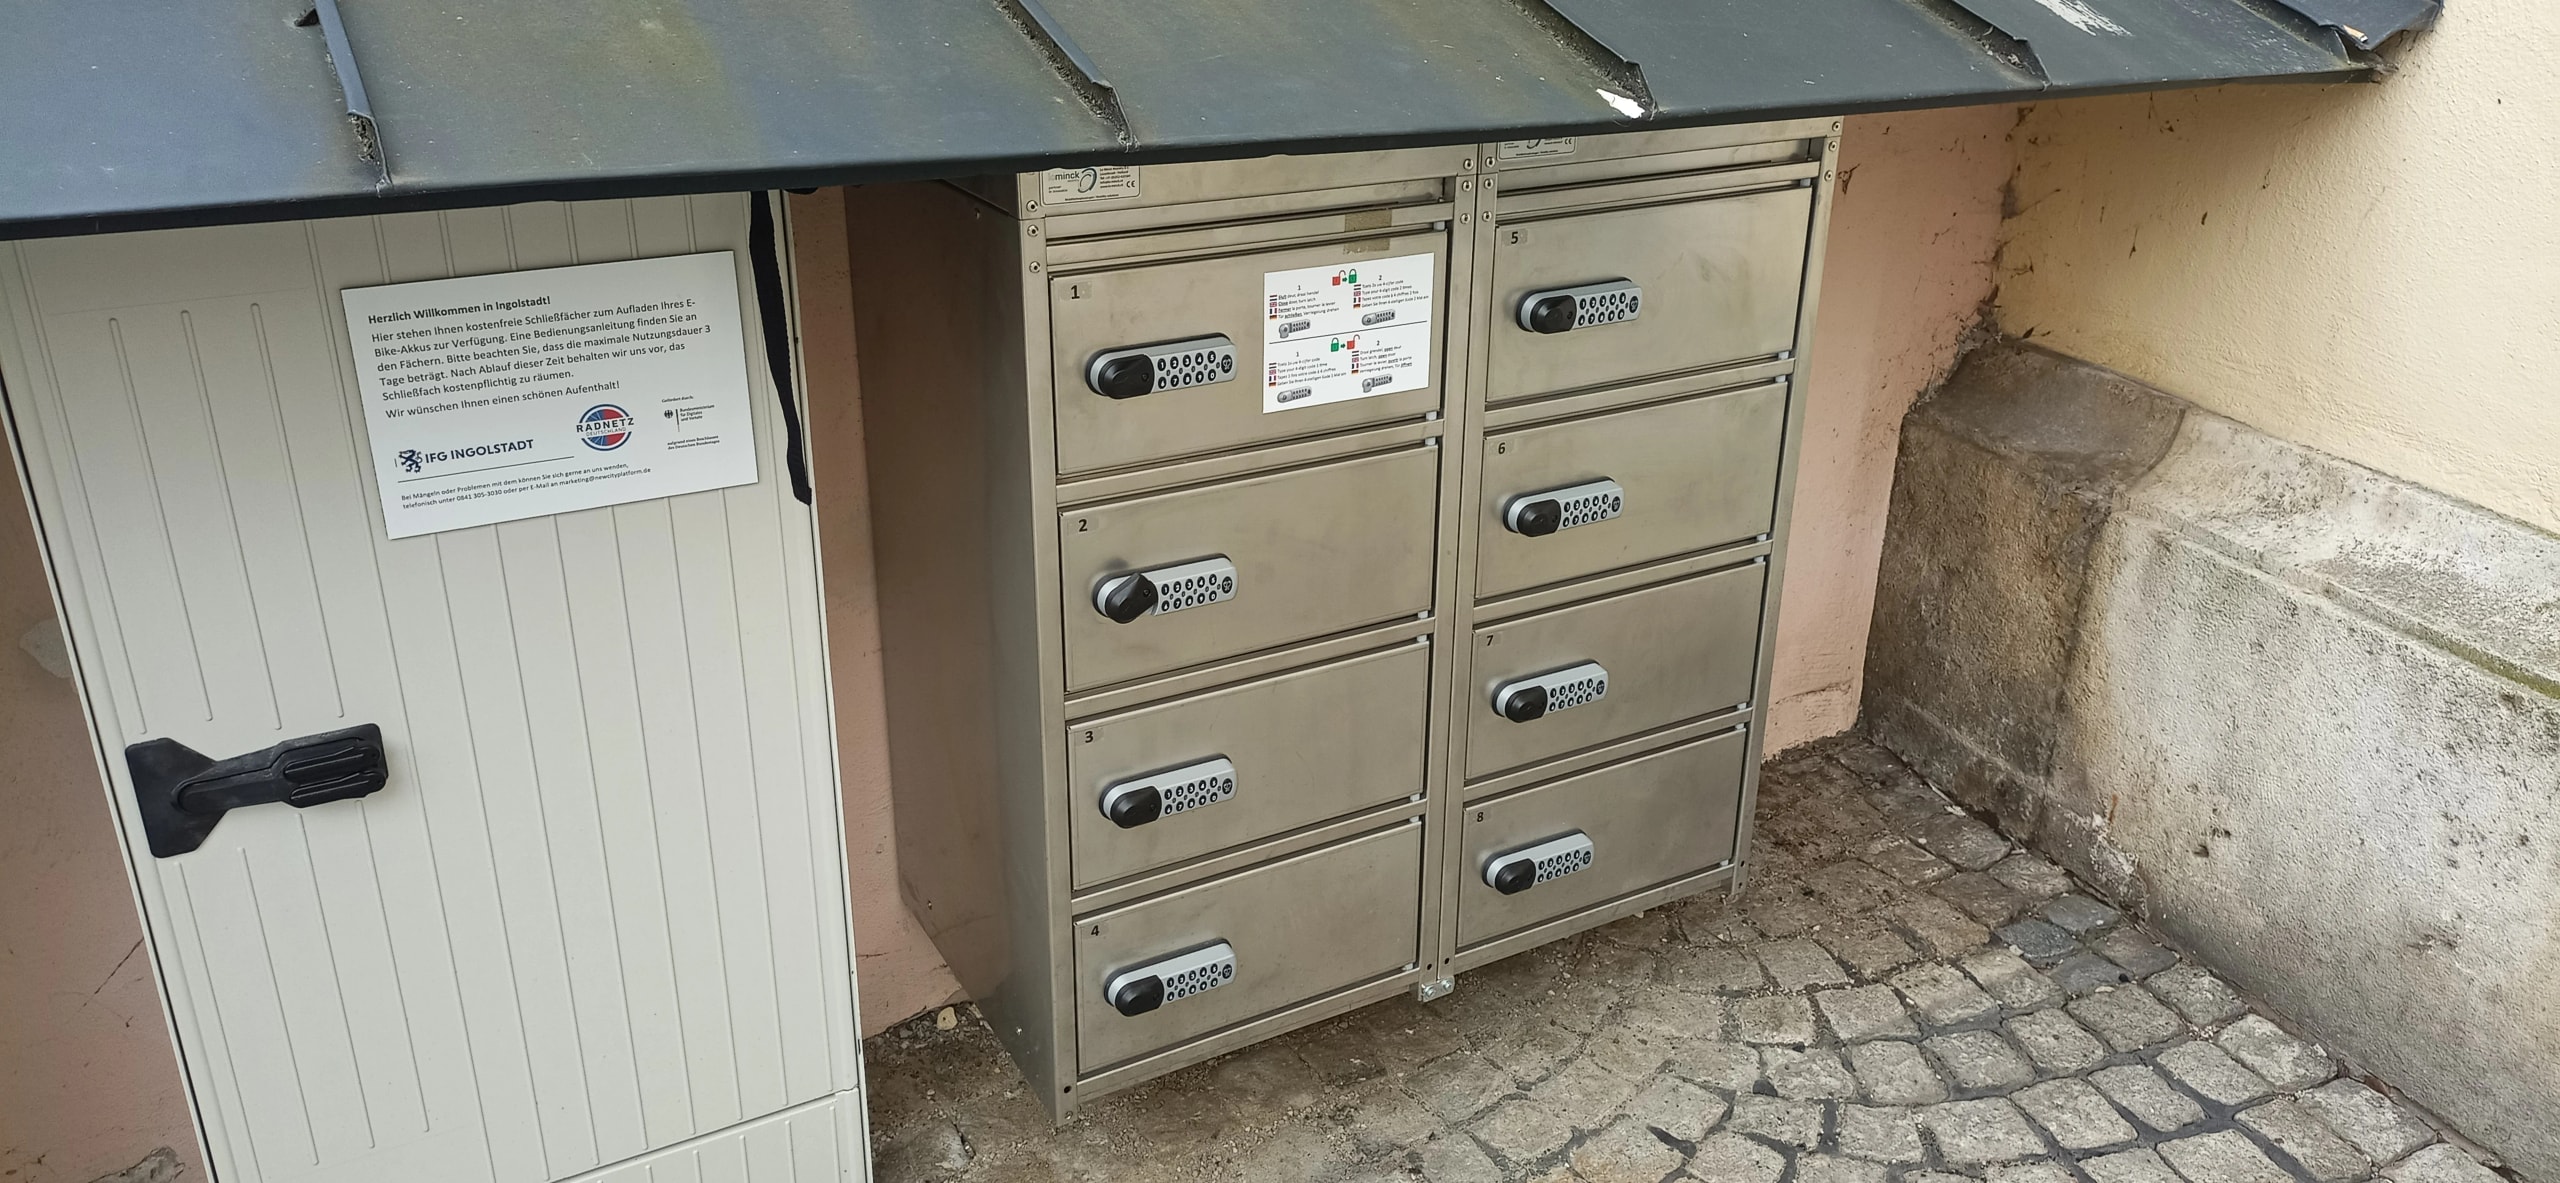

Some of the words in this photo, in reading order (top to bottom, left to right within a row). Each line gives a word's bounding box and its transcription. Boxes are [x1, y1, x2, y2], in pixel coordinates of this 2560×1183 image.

[1511, 232, 1518, 244] 5
[1071, 285, 1080, 299] 1
[368, 311, 411, 324] Herzlich
[413, 305, 481, 319] Willkommen
[483, 302, 493, 311] in
[495, 295, 550, 310] Ingolstadt!
[371, 333, 393, 342] Hier
[396, 329, 432, 340] stehen
[434, 326, 463, 335] Ihnen
[465, 317, 522, 331] kostenfreie
[525, 311, 591, 325] Schließfächer
[593, 309, 613, 317] zum
[616, 303, 658, 315] Aufladen
[661, 301, 684, 310] Ihres
[686, 298, 695, 307] E-
[374, 344, 431, 357] Bike-Akkus
[433, 342, 449, 350] zur
[451, 335, 507, 348] Verfügung.
[510, 332, 531, 341] Eine
[533, 321, 635, 338] Bedienungsanleitung
[637, 316, 667, 326] finden
[669, 314, 683, 323] Sie
[377, 362, 397, 372] den
[399, 358, 444, 369] Fächern.
[446, 354, 470, 363] Bitte
[473, 348, 520, 360] beachten
[522, 345, 540, 354] Sie,
[542, 343, 564, 352] dass
[566, 340, 581, 349] die
[584, 334, 630, 347] maximale
[632, 327, 702, 341] Nutzungsdauer
[705, 325, 711, 333] 3
[379, 377, 405, 387] Tage
[407, 371, 448, 383] beträgt.
[450, 366, 476, 377] Nach
[479, 361, 511, 374] Ablauf
[513, 360, 543, 369] dieser
[545, 356, 565, 366] Zeit
[566, 352, 609, 363] behalten
[611, 349, 627, 357] wir
[629, 348, 646, 356] uns
[648, 345, 667, 353] vor,
[669, 342, 685, 351] das
[382, 385, 441, 401] Schließfach
[443, 377, 517, 393] kostenpflichtig
[533, 371, 574, 381] räumen.
[385, 409, 404, 418] Wir
[407, 403, 459, 415] wünschen
[461, 399, 489, 408] Ihnen
[492, 395, 520, 405] einen
[522, 389, 563, 401] schönen
[565, 380, 619, 395] Aufenthalt!
[576, 417, 634, 433] RADNETZ
[585, 427, 626, 436] DEUTSCHLAND
[425, 451, 447, 463] IFG
[450, 439, 533, 459] INGOLSTADT
[1499, 443, 1505, 454] 6
[402, 499, 437, 509] telefonisch
[530, 482, 549, 490] E-Mail
[559, 468, 651, 485] marketing@newcityplatform.de
[412, 490, 440, 498] Mängeln
[457, 483, 491, 492] Problemen
[1079, 519, 1087, 532] 2
[1487, 635, 1493, 646] 7
[1085, 731, 1093, 743] 3
[1477, 812, 1483, 822] 8
[1091, 926, 1099, 936] 4
